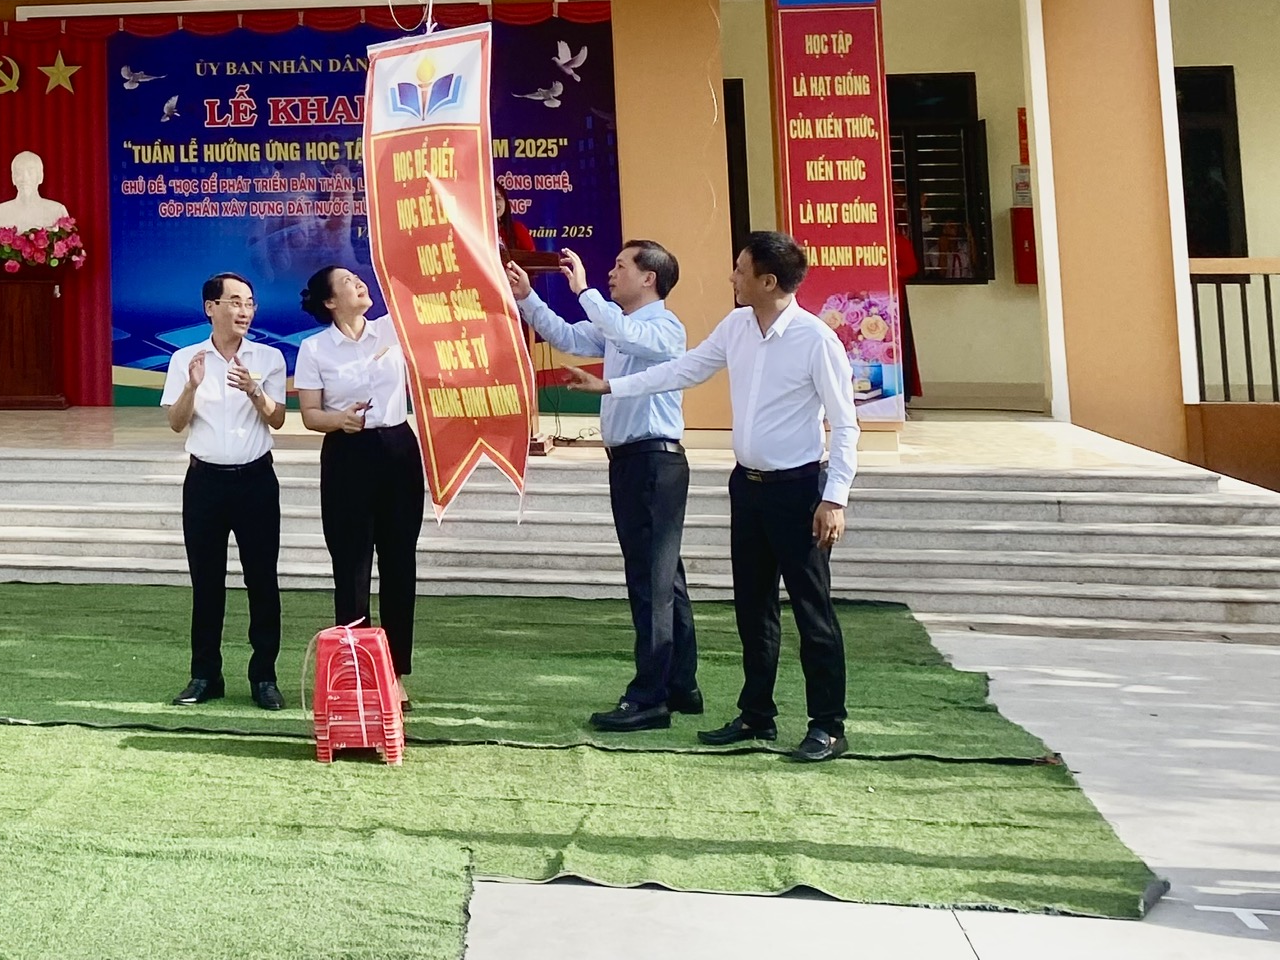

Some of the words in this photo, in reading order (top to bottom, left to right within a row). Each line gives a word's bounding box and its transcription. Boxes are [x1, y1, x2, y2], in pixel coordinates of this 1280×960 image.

[805, 33, 829, 59] HỌC
[830, 30, 853, 59] TẬP
[195, 58, 221, 77] ỦY
[226, 61, 263, 76] BAN
[268, 55, 323, 74] NHÂN
[328, 54, 368, 73] DÂN
[793, 72, 807, 97] LÀ
[810, 76, 831, 101] HẠT
[834, 69, 870, 96] GIỐNG
[204, 84, 258, 128] LỄ
[789, 112, 813, 139] CỦA
[815, 112, 843, 139] KIẾN
[845, 113, 879, 140] THỨC,
[180, 137, 198, 163] LỄ
[203, 137, 261, 162] HƯỞNG
[265, 137, 301, 162] ỨNG
[305, 141, 340, 165] HỌC
[344, 137, 363, 165] TẬ
[393, 150, 414, 188] HỌC
[414, 136, 429, 179] ĐỂ
[430, 137, 458, 182] BIẾT,
[122, 175, 145, 195] CHỦ
[201, 171, 219, 195] ĐỂ
[220, 175, 251, 194] PHÁT
[253, 171, 287, 194] TRIỂN
[290, 172, 316, 194] BẢN
[534, 170, 573, 193] NGHỆ,
[806, 154, 834, 181] KIẾN
[836, 155, 866, 181] THỨC
[159, 200, 184, 218] GÓP
[186, 196, 219, 217] PHẦN
[221, 197, 247, 217] XÂY
[249, 201, 284, 219] DỰNG
[286, 196, 313, 216] ĐẤT
[314, 196, 351, 216] NƯỚC
[396, 197, 419, 236] HỌC
[419, 182, 436, 227] ĐỂ
[799, 199, 814, 224] LÀ
[816, 203, 838, 228] HẠT
[841, 195, 878, 224] GIỐNG
[529, 226, 557, 238] năm
[561, 225, 593, 238] 2025
[417, 243, 442, 282] HỌC
[440, 228, 460, 273] ĐỂ
[802, 240, 819, 267] ỦA
[821, 246, 853, 271] HẠNH
[855, 241, 888, 267] PHÚC
[412, 291, 453, 325] CHUNG
[450, 278, 488, 323] SỐNG,
[434, 339, 459, 377] HỌC
[455, 326, 475, 370] ĐỂ
[471, 334, 490, 375] TỰ
[460, 386, 490, 425] ĐỊNH
[487, 379, 521, 416] MÌNH
